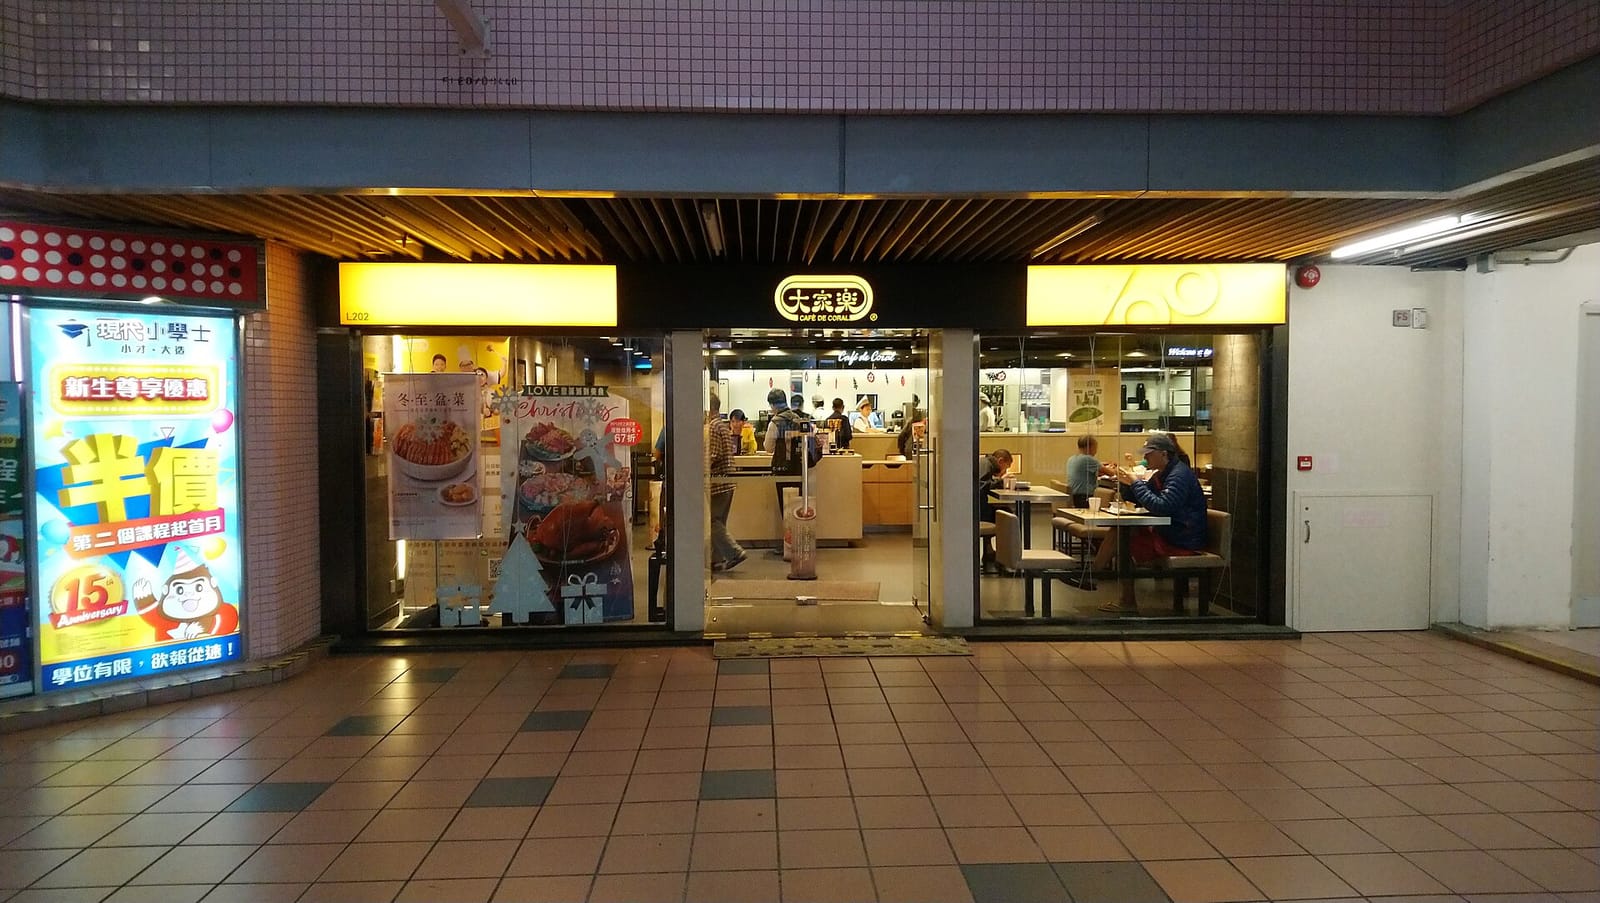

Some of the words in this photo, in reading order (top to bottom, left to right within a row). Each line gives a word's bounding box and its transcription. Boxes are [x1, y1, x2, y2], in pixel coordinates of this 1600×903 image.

[346, 312, 369, 321] L202
[1396, 312, 1409, 321] FS
[97, 318, 211, 342] 現代小學士
[838, 350, 858, 366] Café
[859, 351, 870, 362] de
[871, 350, 897, 362] Coral
[65, 377, 208, 399] 新生尊享優惠
[528, 386, 559, 396] LOVE
[614, 433, 636, 443] 67折
[58, 433, 219, 524] 半價
[73, 515, 222, 552] 第二個課程起首月
[57, 604, 123, 628] Anniversary
